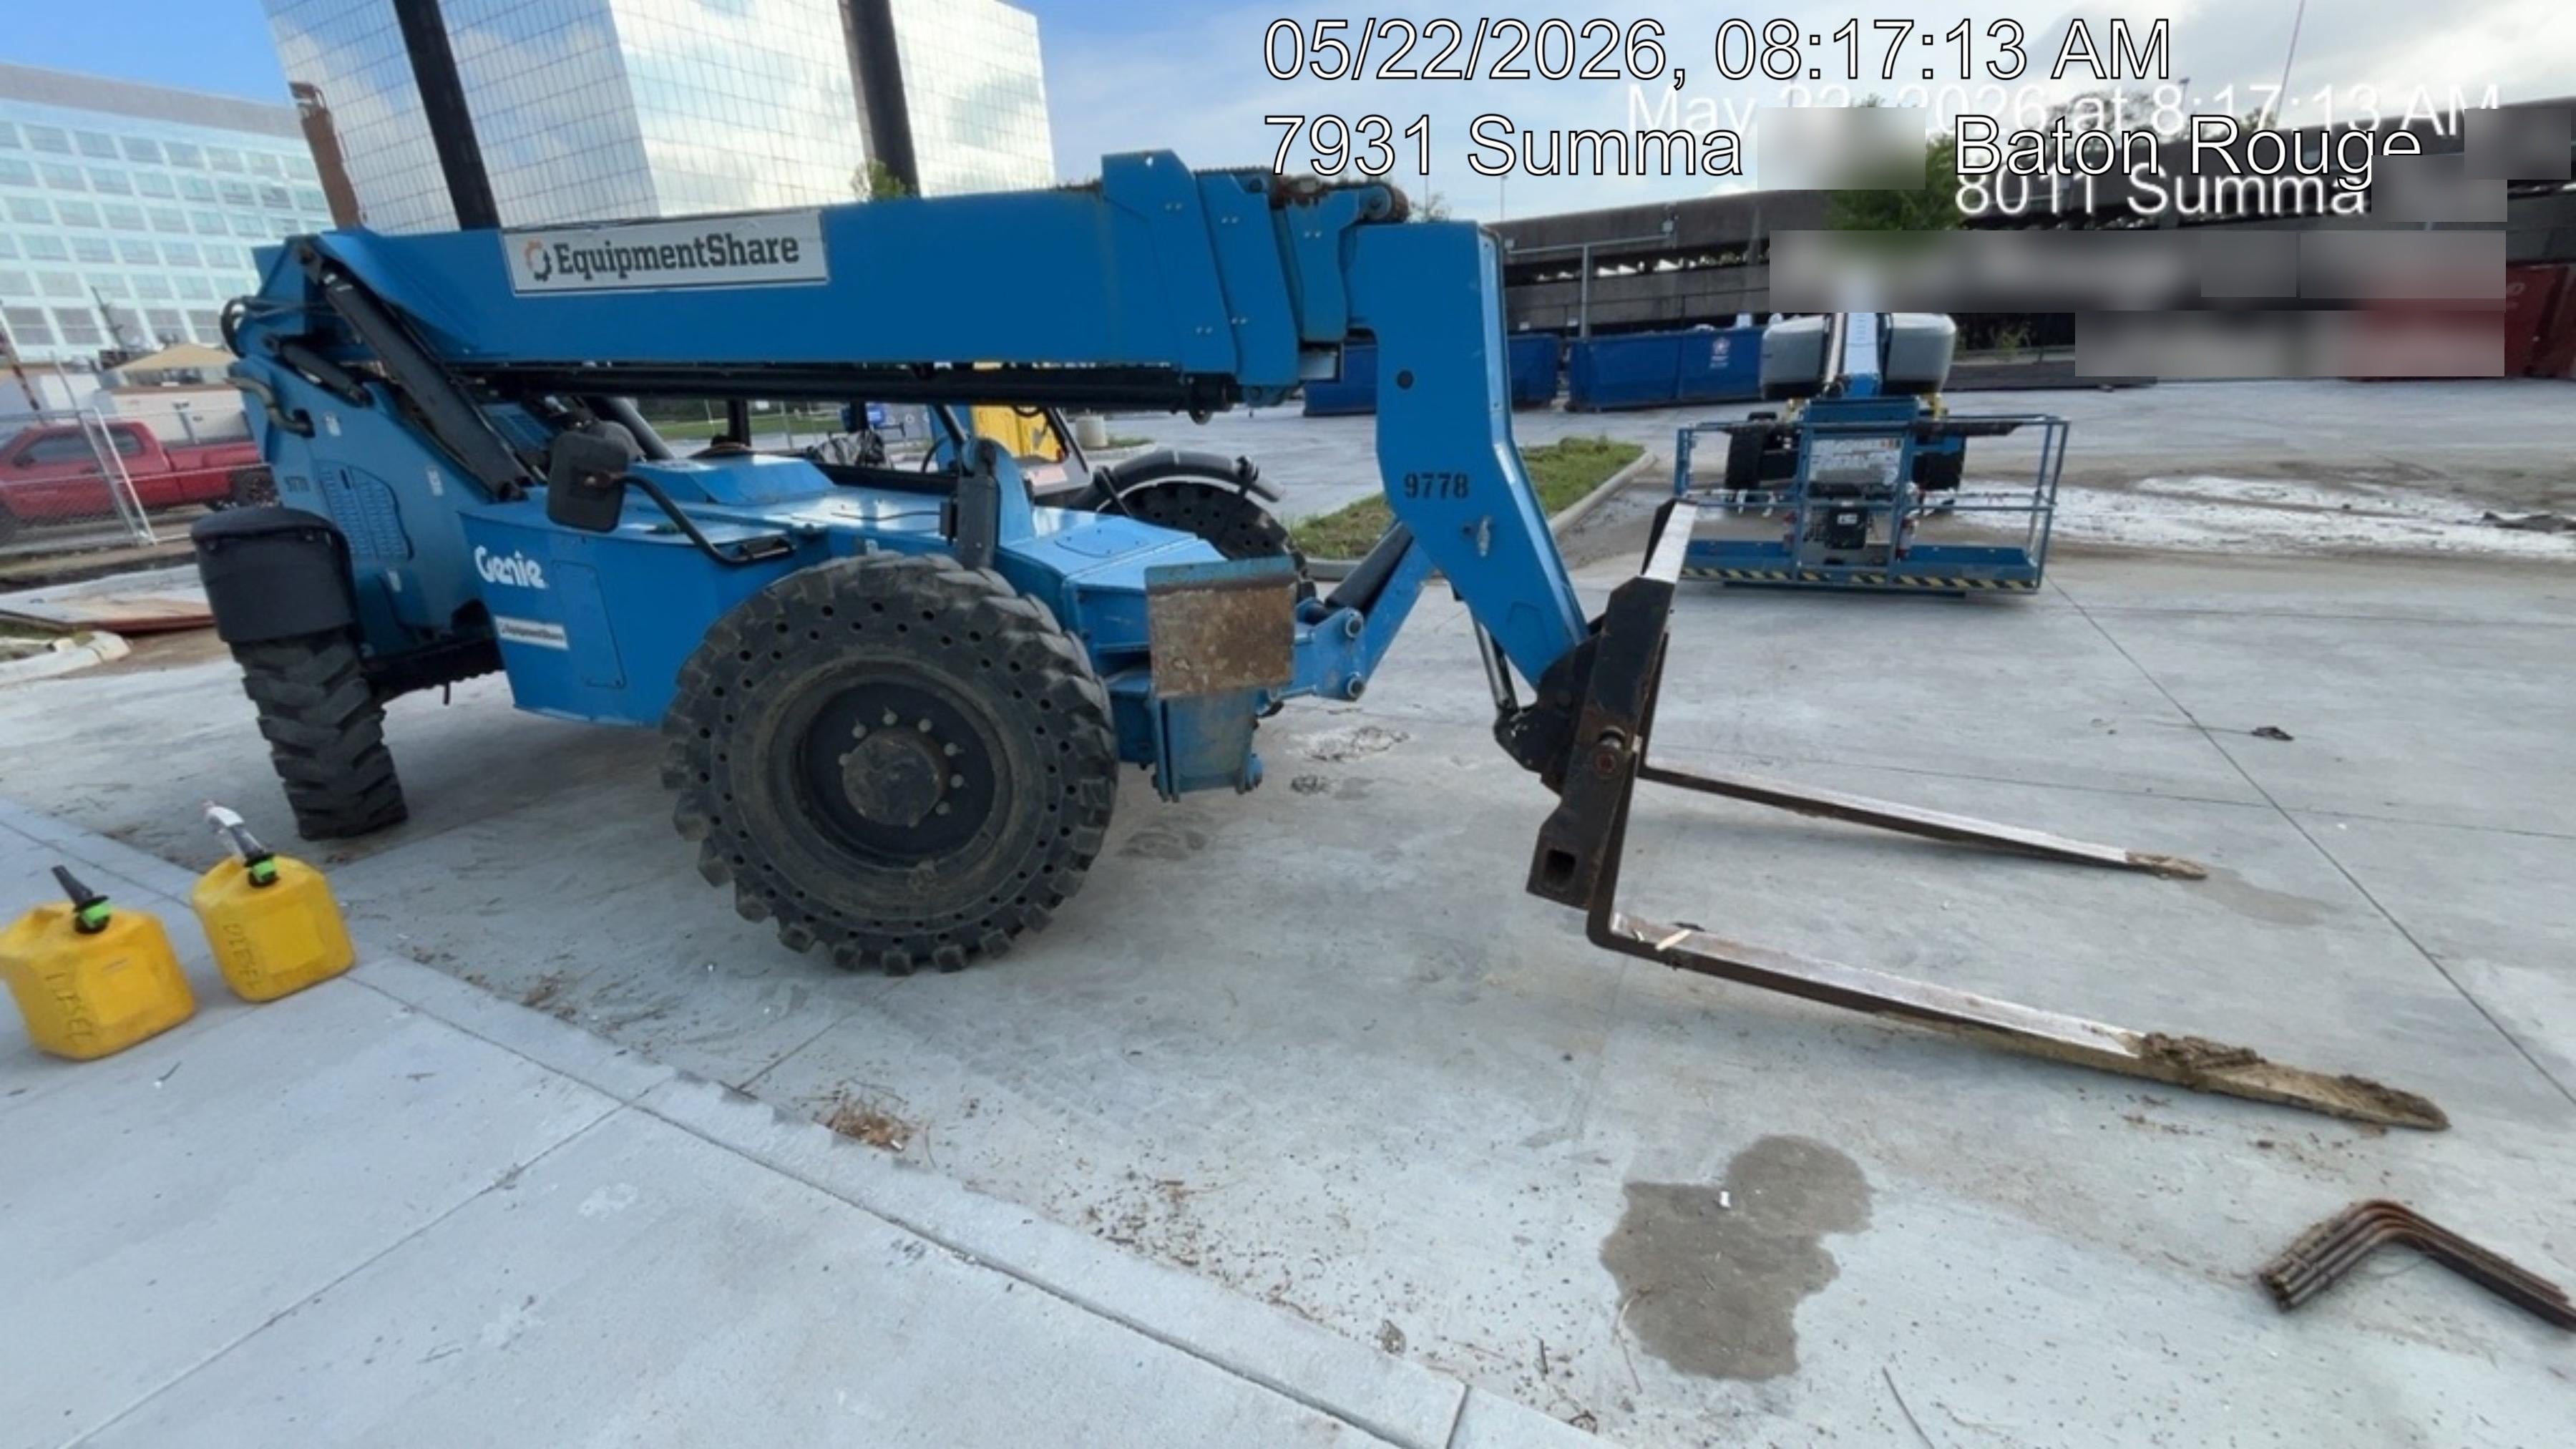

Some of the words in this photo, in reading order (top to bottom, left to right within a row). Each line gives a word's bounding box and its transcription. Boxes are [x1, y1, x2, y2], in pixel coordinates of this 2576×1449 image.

[553, 233, 800, 281] EquipmentShare
[1405, 472, 1468, 499] 9778
[474, 544, 546, 589] Genie
